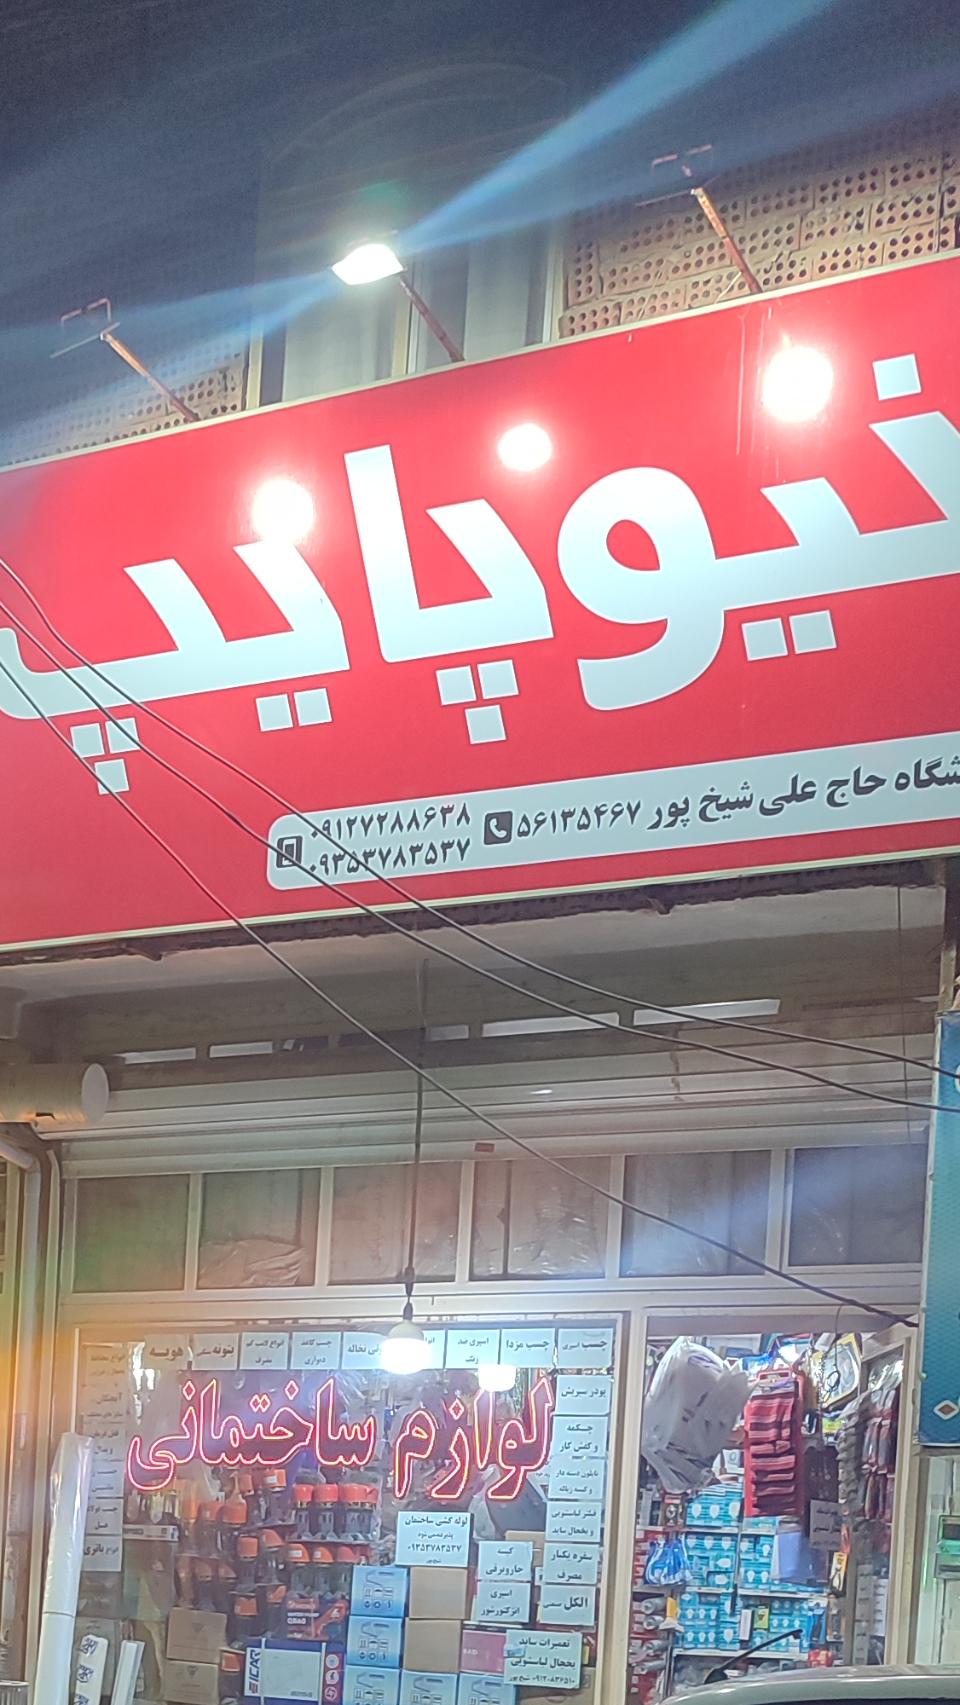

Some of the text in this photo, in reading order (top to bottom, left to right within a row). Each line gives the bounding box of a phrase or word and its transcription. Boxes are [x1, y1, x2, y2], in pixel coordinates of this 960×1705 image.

[698, 780, 753, 822] شیخ
[759, 773, 816, 816] علی
[826, 765, 886, 807] حاج
[311, 802, 471, 840] ۰۹۱۲۷۲۸۸۶۳۸
[517, 800, 641, 837] ۵۶۱۳۵۴۶۷
[646, 796, 690, 830] پور
[127, 1376, 555, 1500] لوازم ساختمانی
[563, 1596, 588, 1611] الکل
